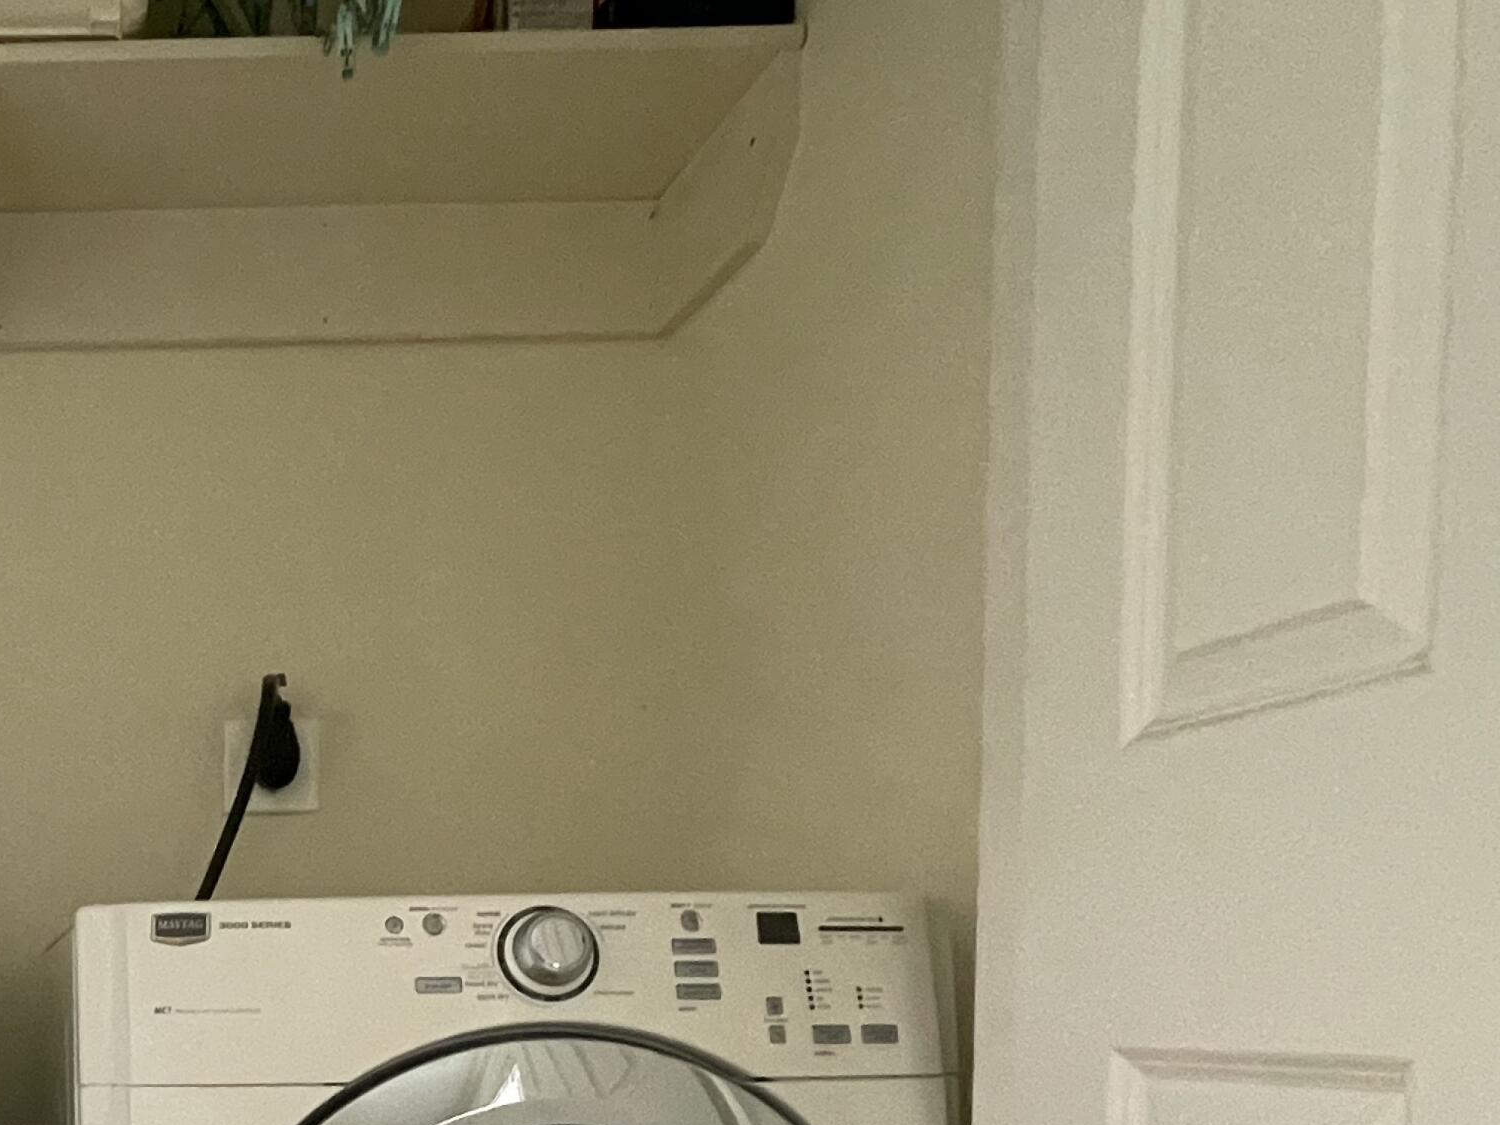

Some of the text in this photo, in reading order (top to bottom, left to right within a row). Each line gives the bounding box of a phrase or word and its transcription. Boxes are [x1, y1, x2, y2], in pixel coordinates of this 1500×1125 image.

[157, 918, 204, 930] MAYTAG
[219, 921, 292, 929] 3000 SERIES
